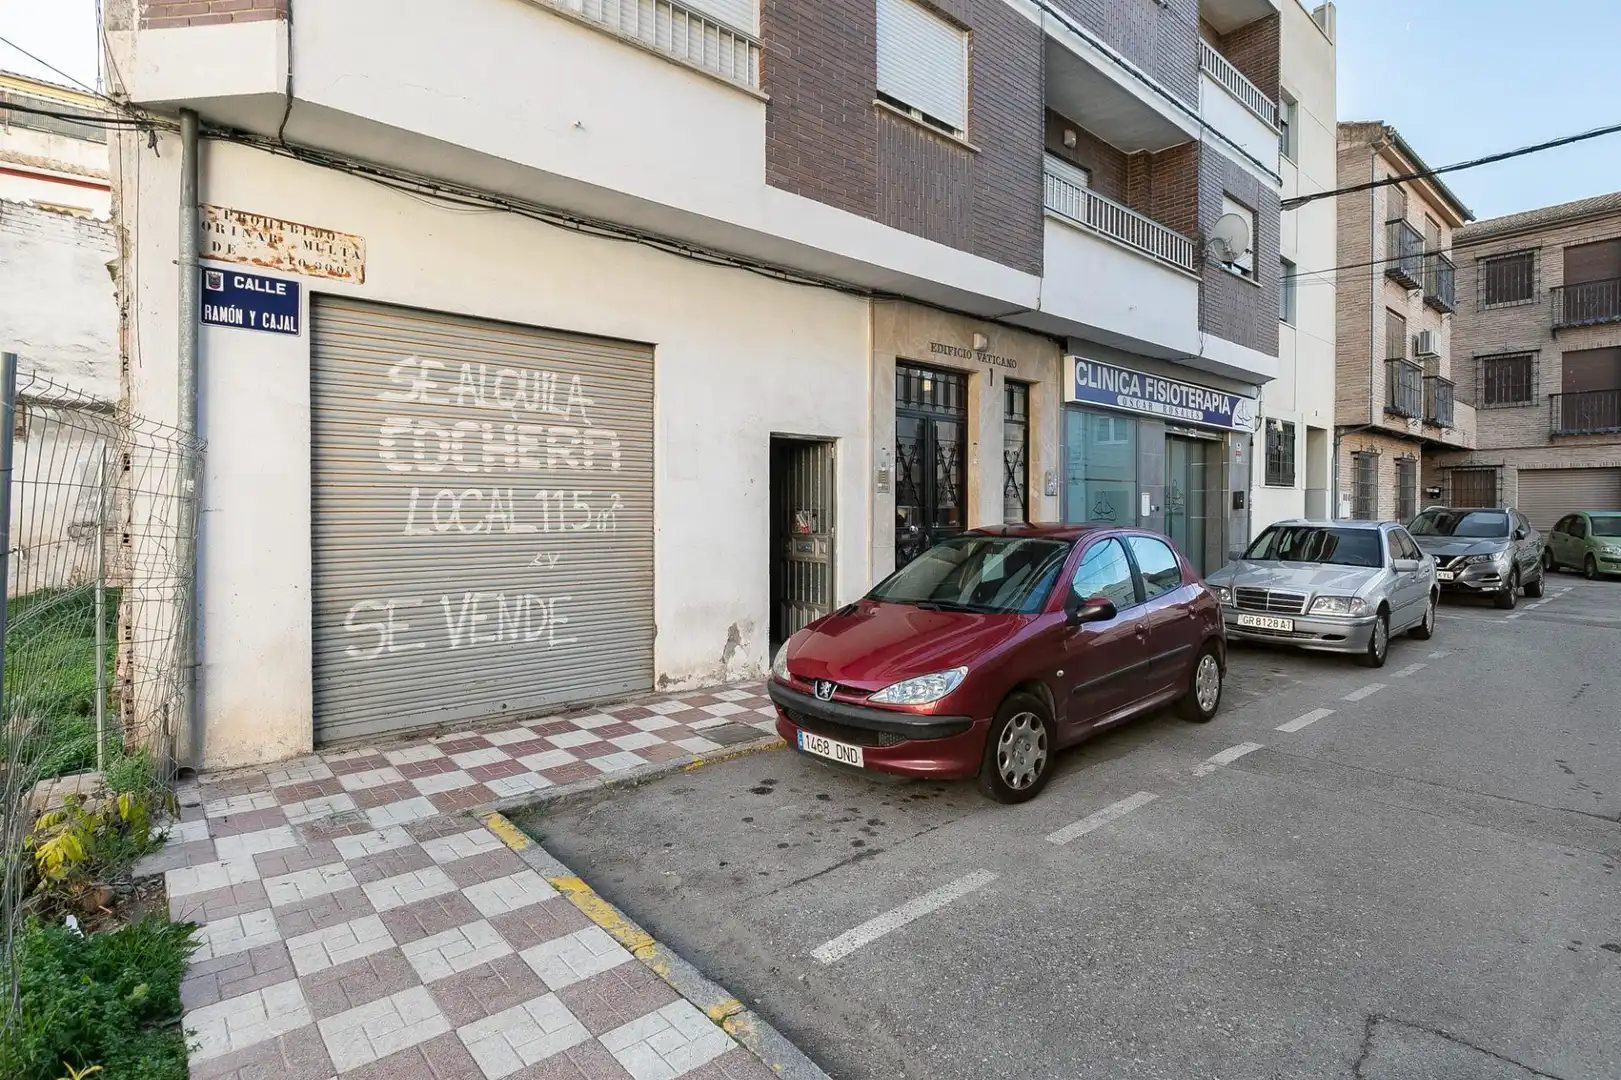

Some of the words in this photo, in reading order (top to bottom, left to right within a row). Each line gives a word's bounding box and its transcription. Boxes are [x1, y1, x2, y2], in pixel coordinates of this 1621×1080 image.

[201, 220, 279, 244] ORINAR
[303, 239, 361, 260] MULTA
[212, 241, 236, 255] DE
[234, 275, 287, 296] CALLE
[204, 304, 243, 325] RAMÓN
[249, 310, 256, 326] Y
[262, 311, 298, 333] CAJAL
[930, 342, 972, 360] EDIFICIO
[976, 352, 1018, 369] VATICANO
[377, 356, 446, 405] SE
[449, 362, 595, 425] ALQUILA
[1075, 361, 1141, 398] CLINICA
[1145, 376, 1231, 416] FISIOTERAPIA
[1122, 396, 1153, 411] OSCAR
[1162, 404, 1201, 419] ROSALES
[379, 417, 622, 473] COCHERA
[403, 487, 538, 536] LOCAL
[535, 489, 593, 533] 115
[343, 597, 427, 660] SE
[439, 590, 578, 649] VENDE
[805, 734, 830, 756] 1468
[835, 743, 858, 764] DND
